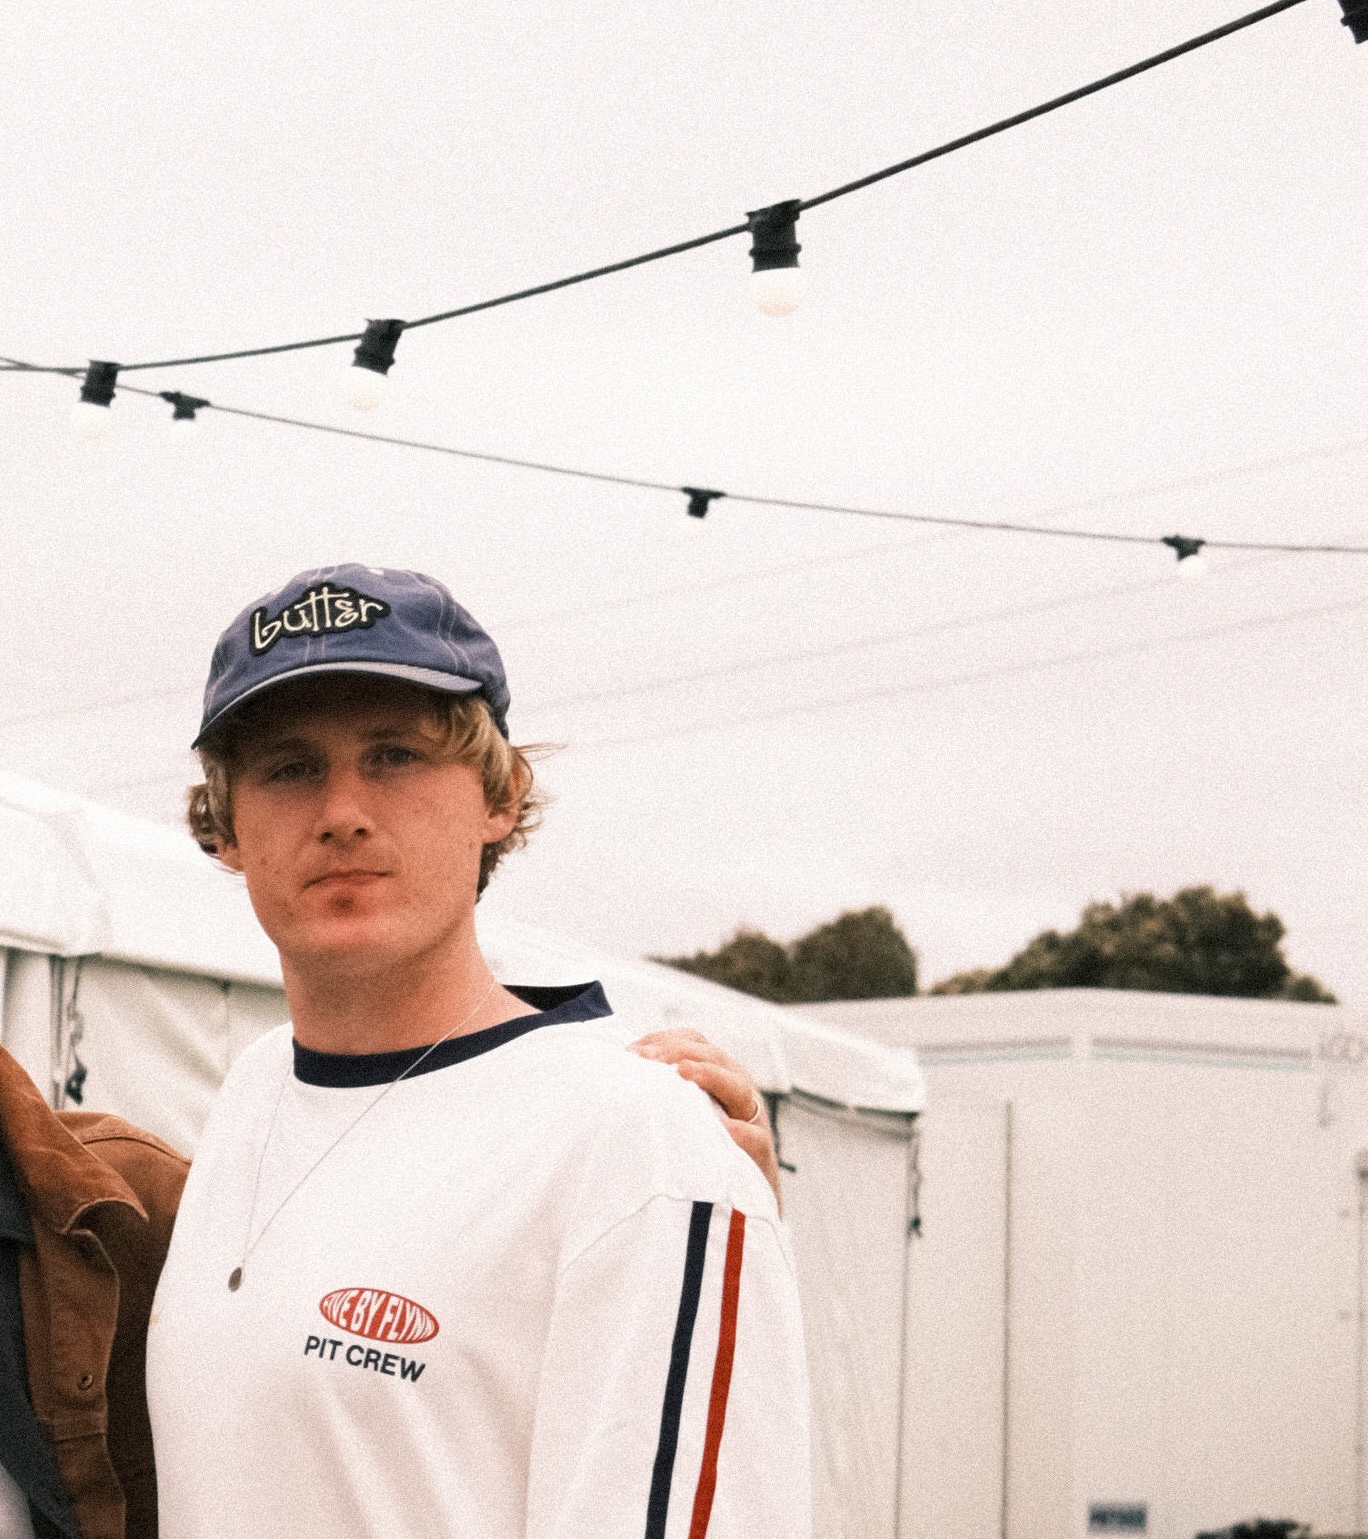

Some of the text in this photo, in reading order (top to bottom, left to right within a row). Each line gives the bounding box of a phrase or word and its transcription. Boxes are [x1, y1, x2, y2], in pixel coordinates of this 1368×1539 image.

[254, 586, 383, 649] butter
[350, 1289, 387, 1335] BY
[304, 1335, 426, 1382] PIT CREW
